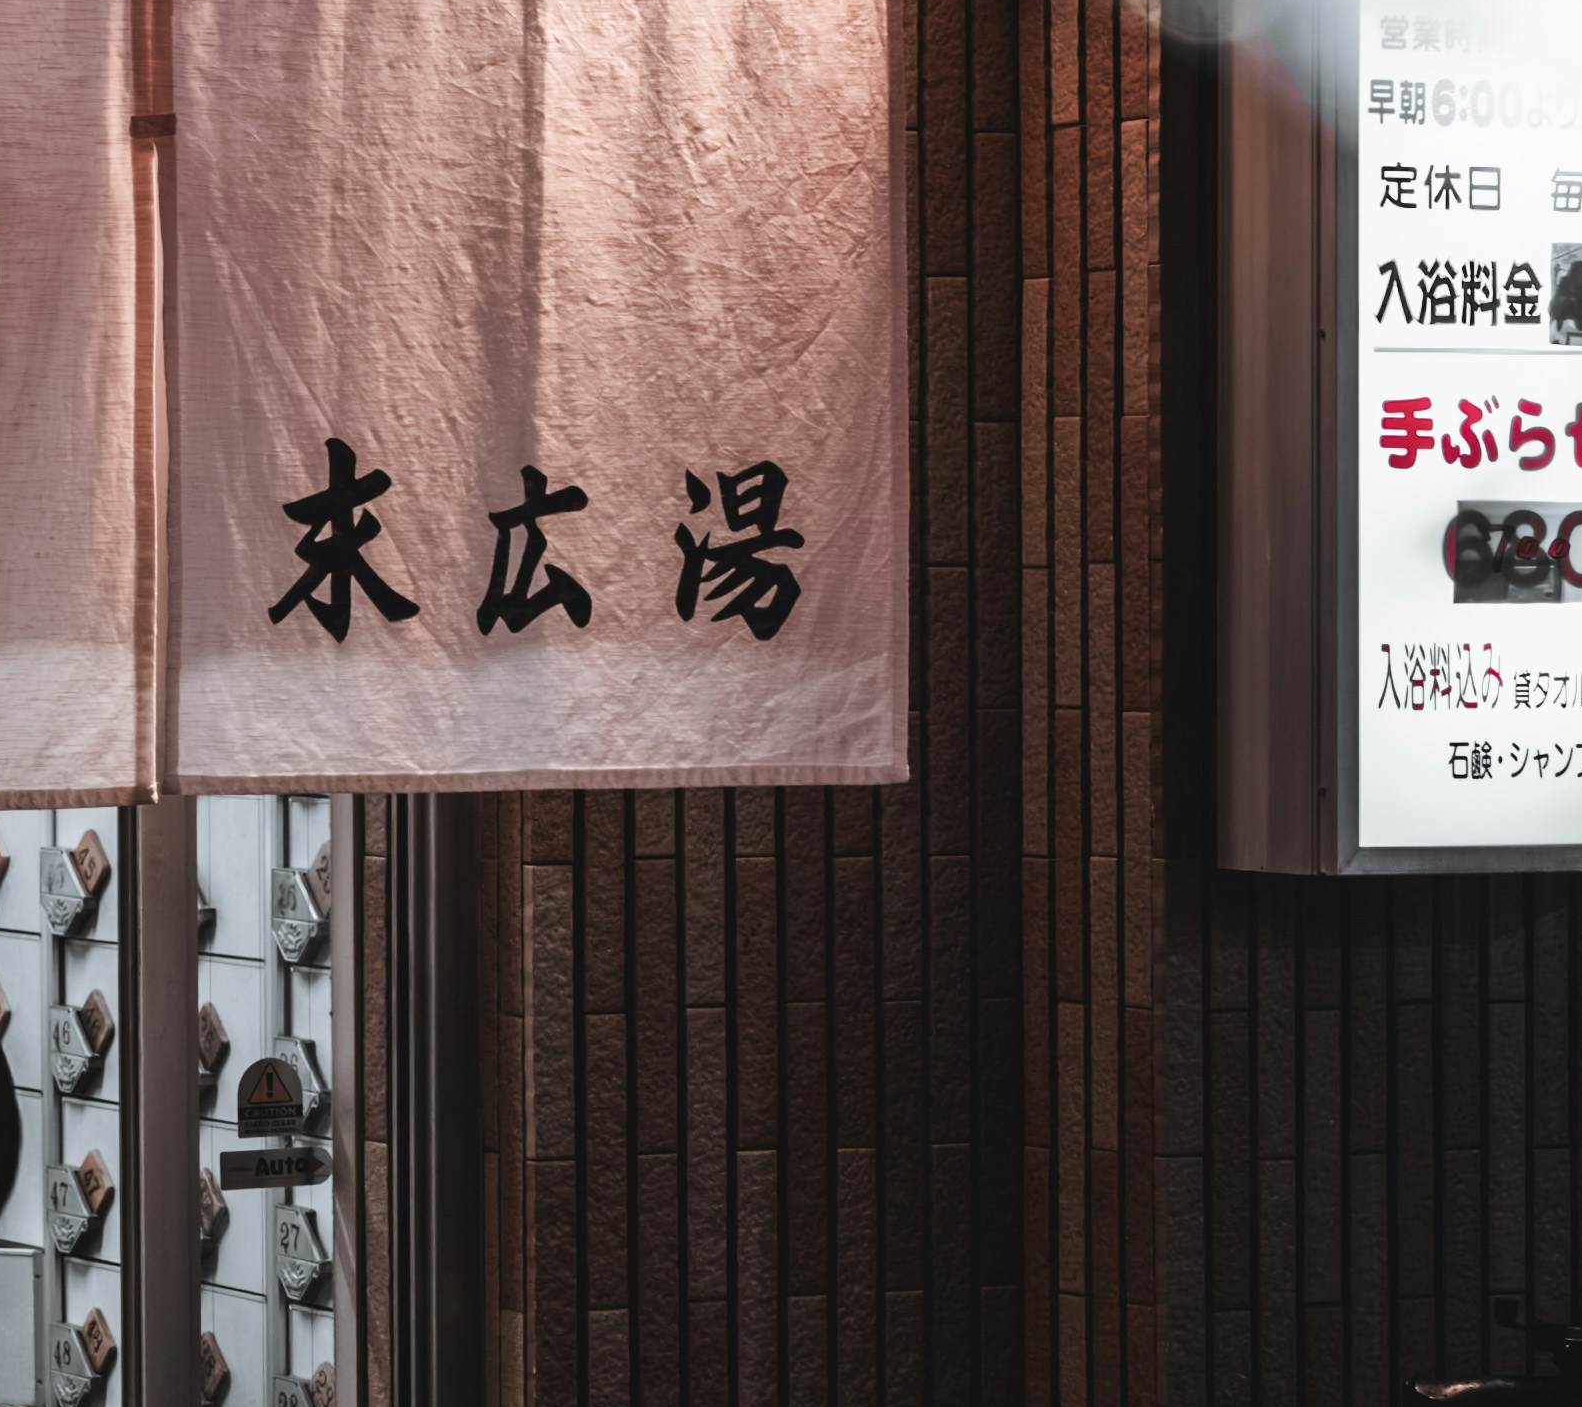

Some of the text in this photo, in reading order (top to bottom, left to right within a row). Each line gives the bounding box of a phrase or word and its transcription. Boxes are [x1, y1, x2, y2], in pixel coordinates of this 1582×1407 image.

[1380, 162, 1501, 211] 定休日
[1376, 262, 1543, 327] 入浴料金
[268, 437, 806, 644] 末広湯
[1379, 643, 1503, 710] 入浴料込み
[79, 848, 97, 880] 45
[244, 1106, 297, 1119] CAUTION
[254, 1156, 310, 1177] Auto
[279, 1221, 300, 1253] 27
[54, 1340, 72, 1370] 48
